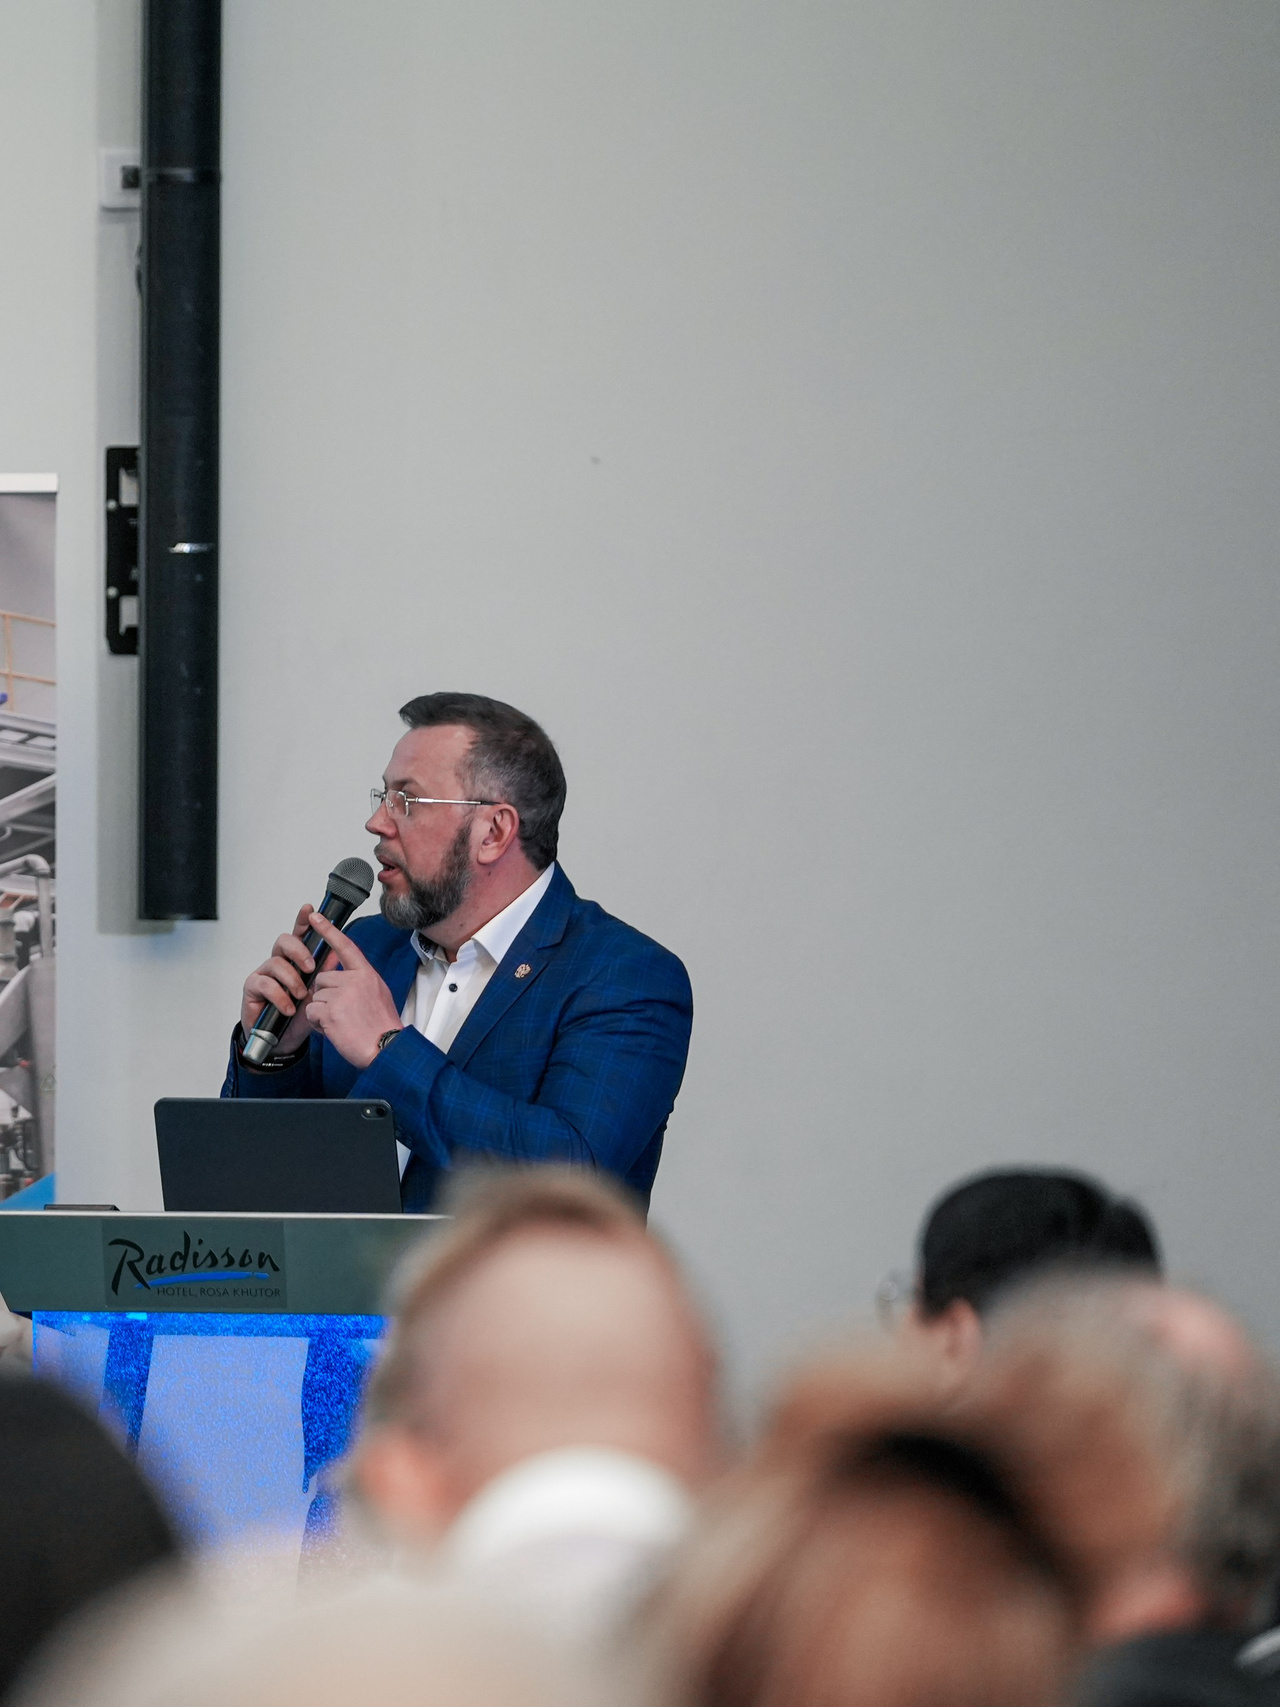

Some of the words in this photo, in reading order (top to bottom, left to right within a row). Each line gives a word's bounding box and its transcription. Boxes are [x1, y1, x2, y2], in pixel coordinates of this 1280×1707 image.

[107, 1230, 281, 1296] Radisson
[157, 1287, 198, 1298] HOTEL,
[199, 1287, 230, 1297] ROSA
[233, 1287, 281, 1298] KHUTOR
